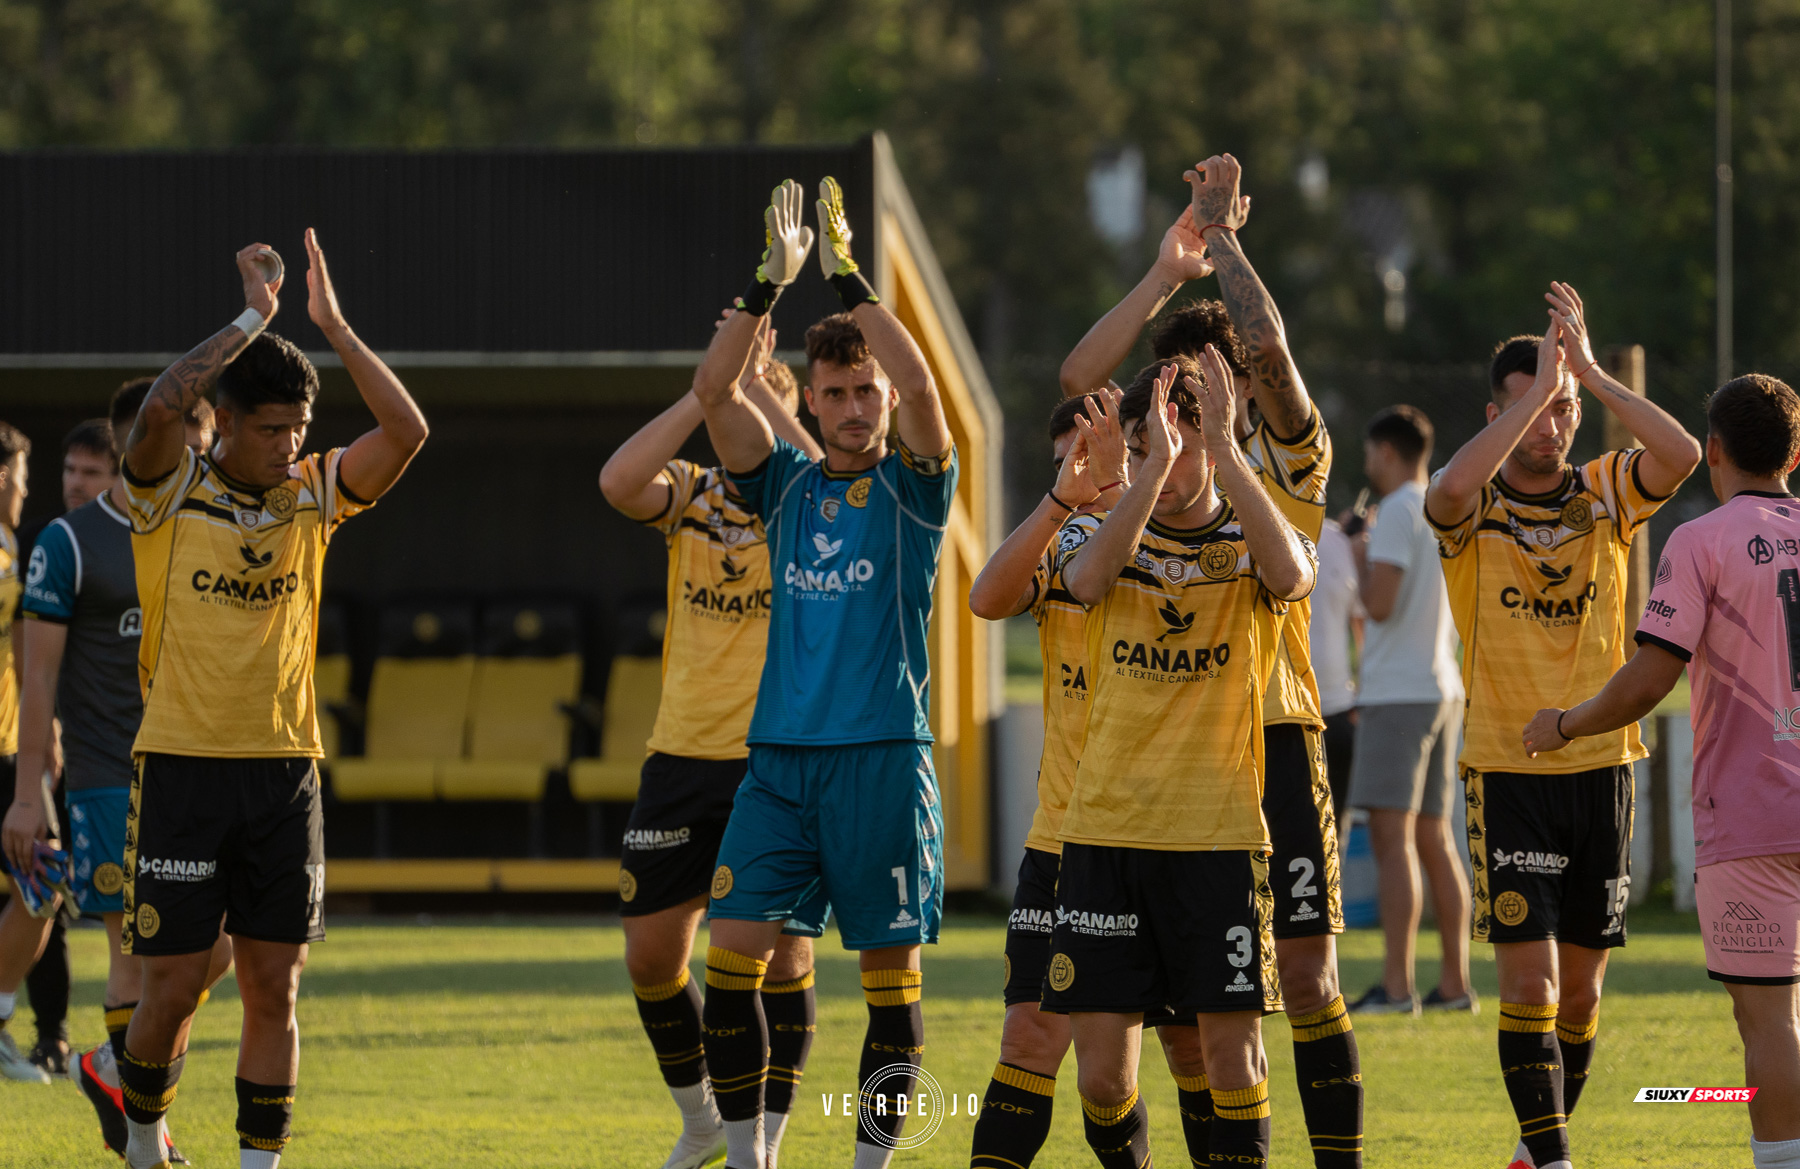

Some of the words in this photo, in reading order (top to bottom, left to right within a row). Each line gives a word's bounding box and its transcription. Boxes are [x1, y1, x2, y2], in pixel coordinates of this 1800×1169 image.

[1776, 539, 1800, 556] AB
[784, 558, 875, 593] CANAIO
[191, 569, 299, 602] CANARO
[1115, 667, 1125, 676] AL
[1128, 669, 1165, 683] TEXTILE
[891, 866, 909, 905] 1
[1288, 857, 1318, 898] 2
[1018, 923, 1040, 932] TEXTILE
[1068, 909, 1139, 931] CANARIO
[1712, 921, 1781, 934] RICARDO
[1079, 927, 1103, 936] TEXTILE
[1712, 934, 1785, 948] CANIGLIA
[1225, 925, 1253, 968] 3
